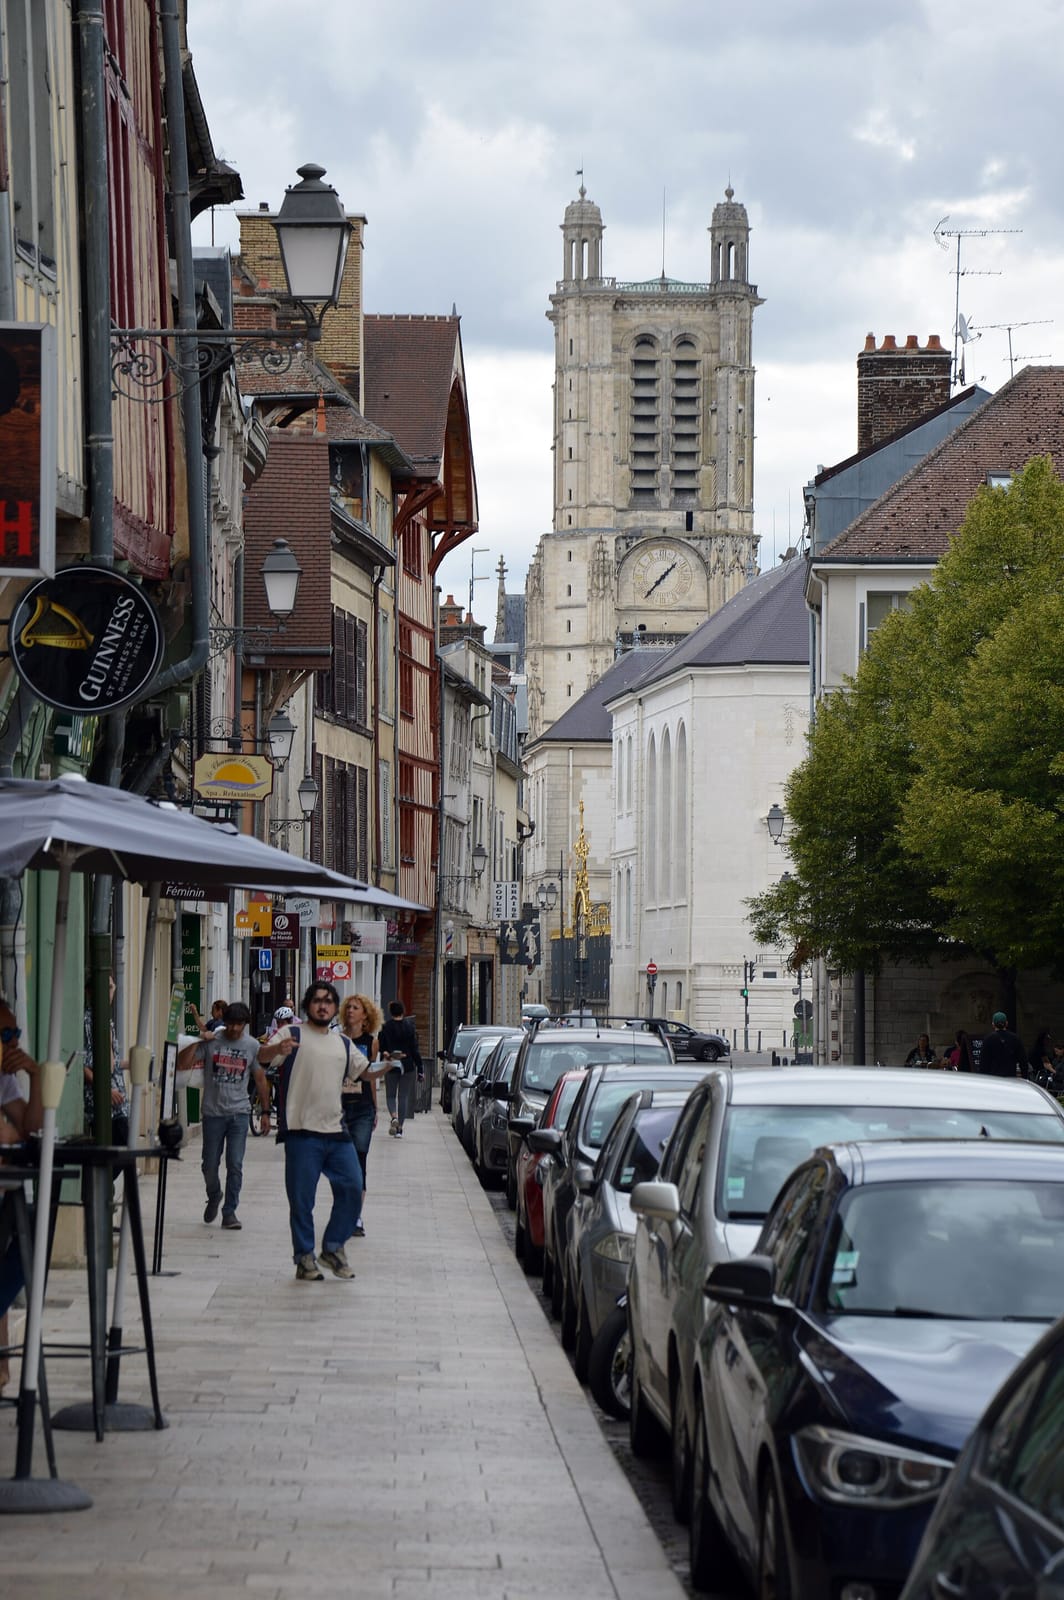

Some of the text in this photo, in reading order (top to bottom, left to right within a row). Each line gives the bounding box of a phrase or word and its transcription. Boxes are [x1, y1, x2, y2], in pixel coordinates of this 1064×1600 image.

[78, 595, 136, 702] GUINNESS
[106, 612, 145, 697] ST JAMES'S GATE
[132, 623, 149, 658] IRELAND
[165, 884, 206, 898] Féminin
[495, 883, 503, 919] POULET
